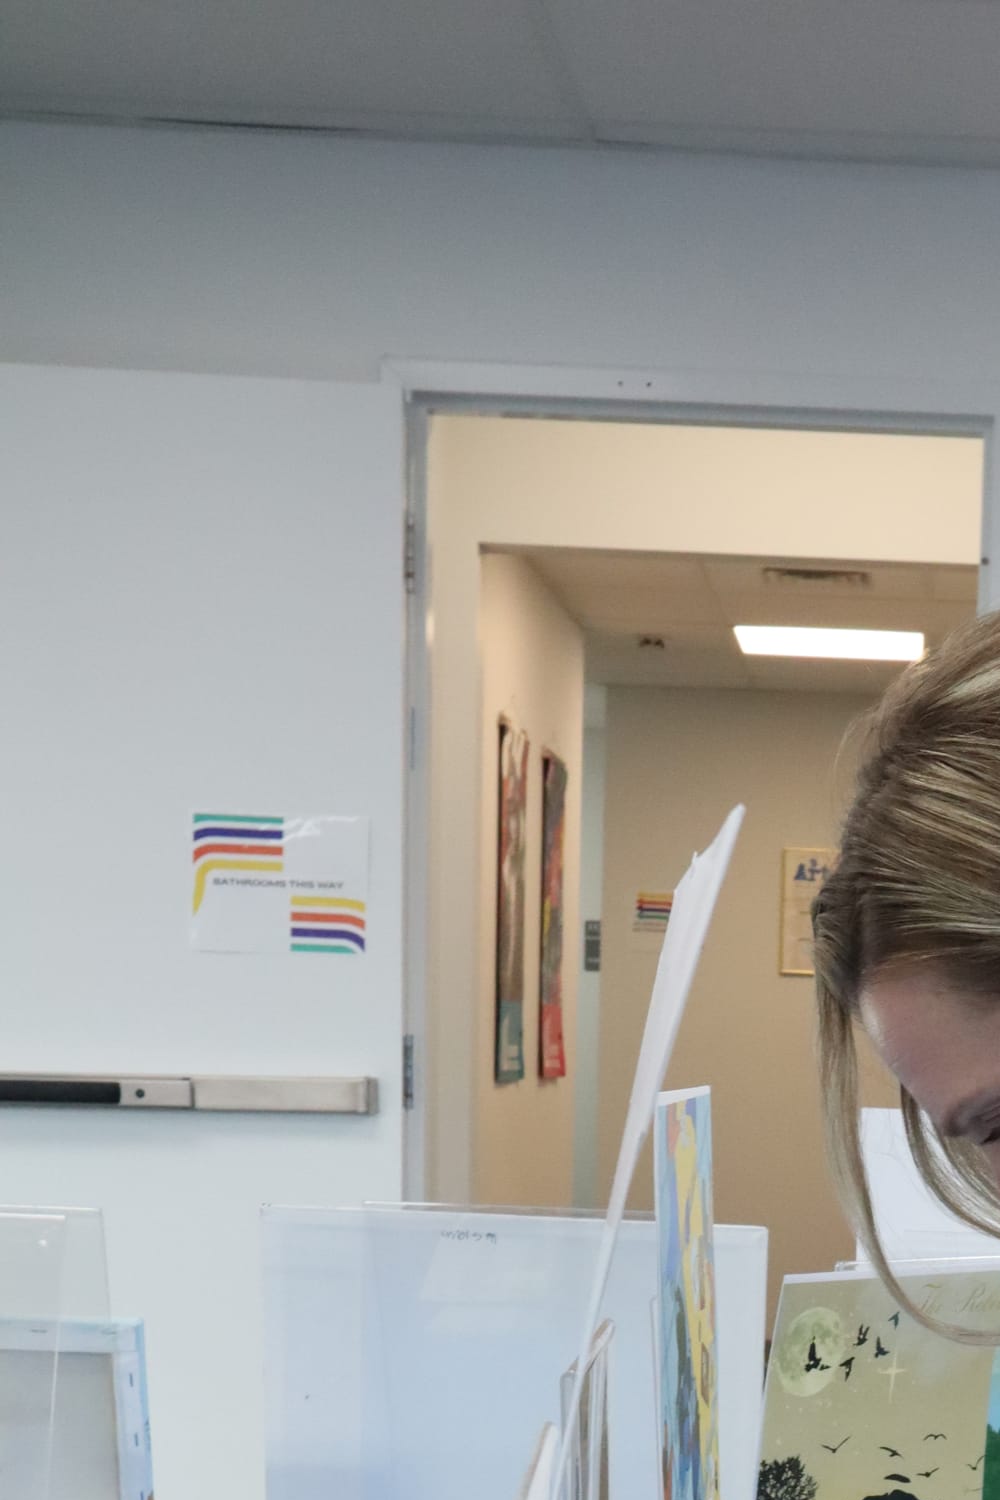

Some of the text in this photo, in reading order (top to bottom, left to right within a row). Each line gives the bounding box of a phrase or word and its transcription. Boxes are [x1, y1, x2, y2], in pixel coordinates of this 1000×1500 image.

[212, 877, 343, 889] BATHROOMS THIS WAY
